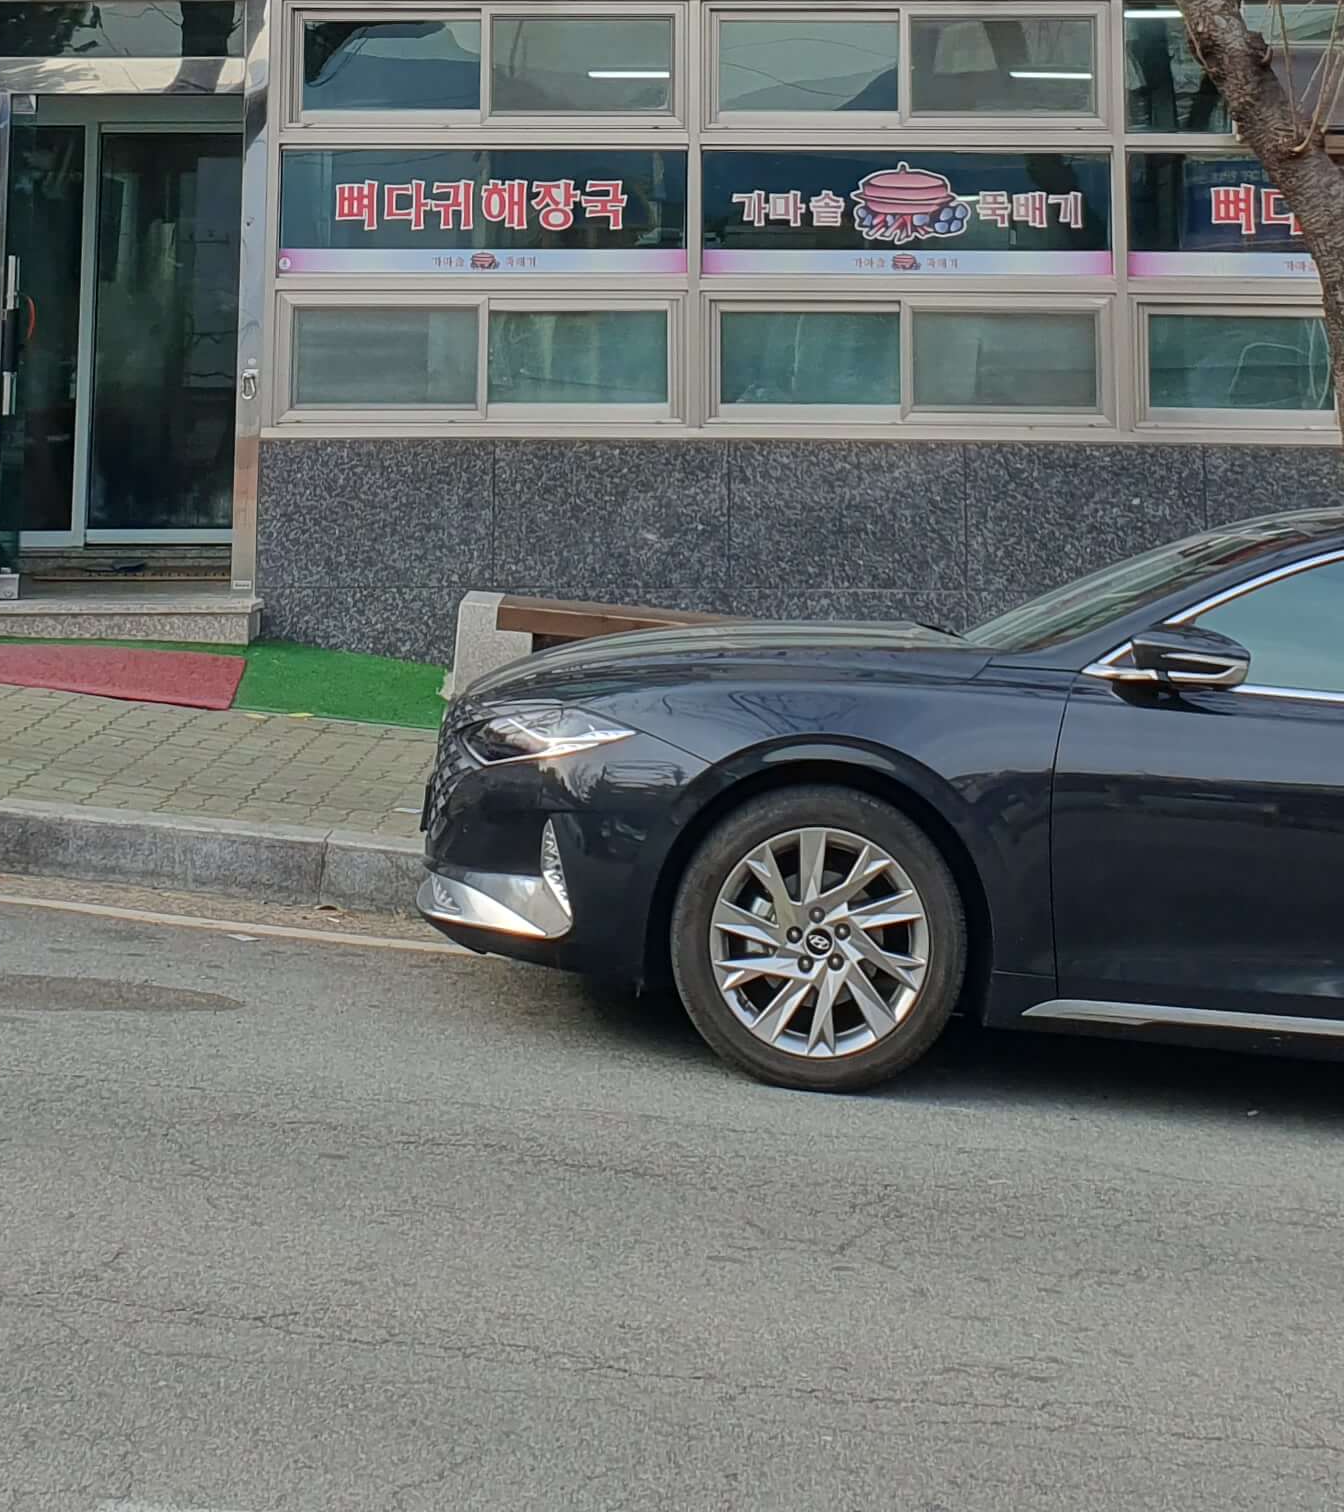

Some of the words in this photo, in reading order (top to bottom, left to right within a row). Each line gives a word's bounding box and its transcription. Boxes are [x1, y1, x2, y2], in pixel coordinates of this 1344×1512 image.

[335, 179, 628, 231] 뼈다귀해장국
[731, 190, 845, 228] 가마솥
[976, 190, 1083, 229] 뚝배기
